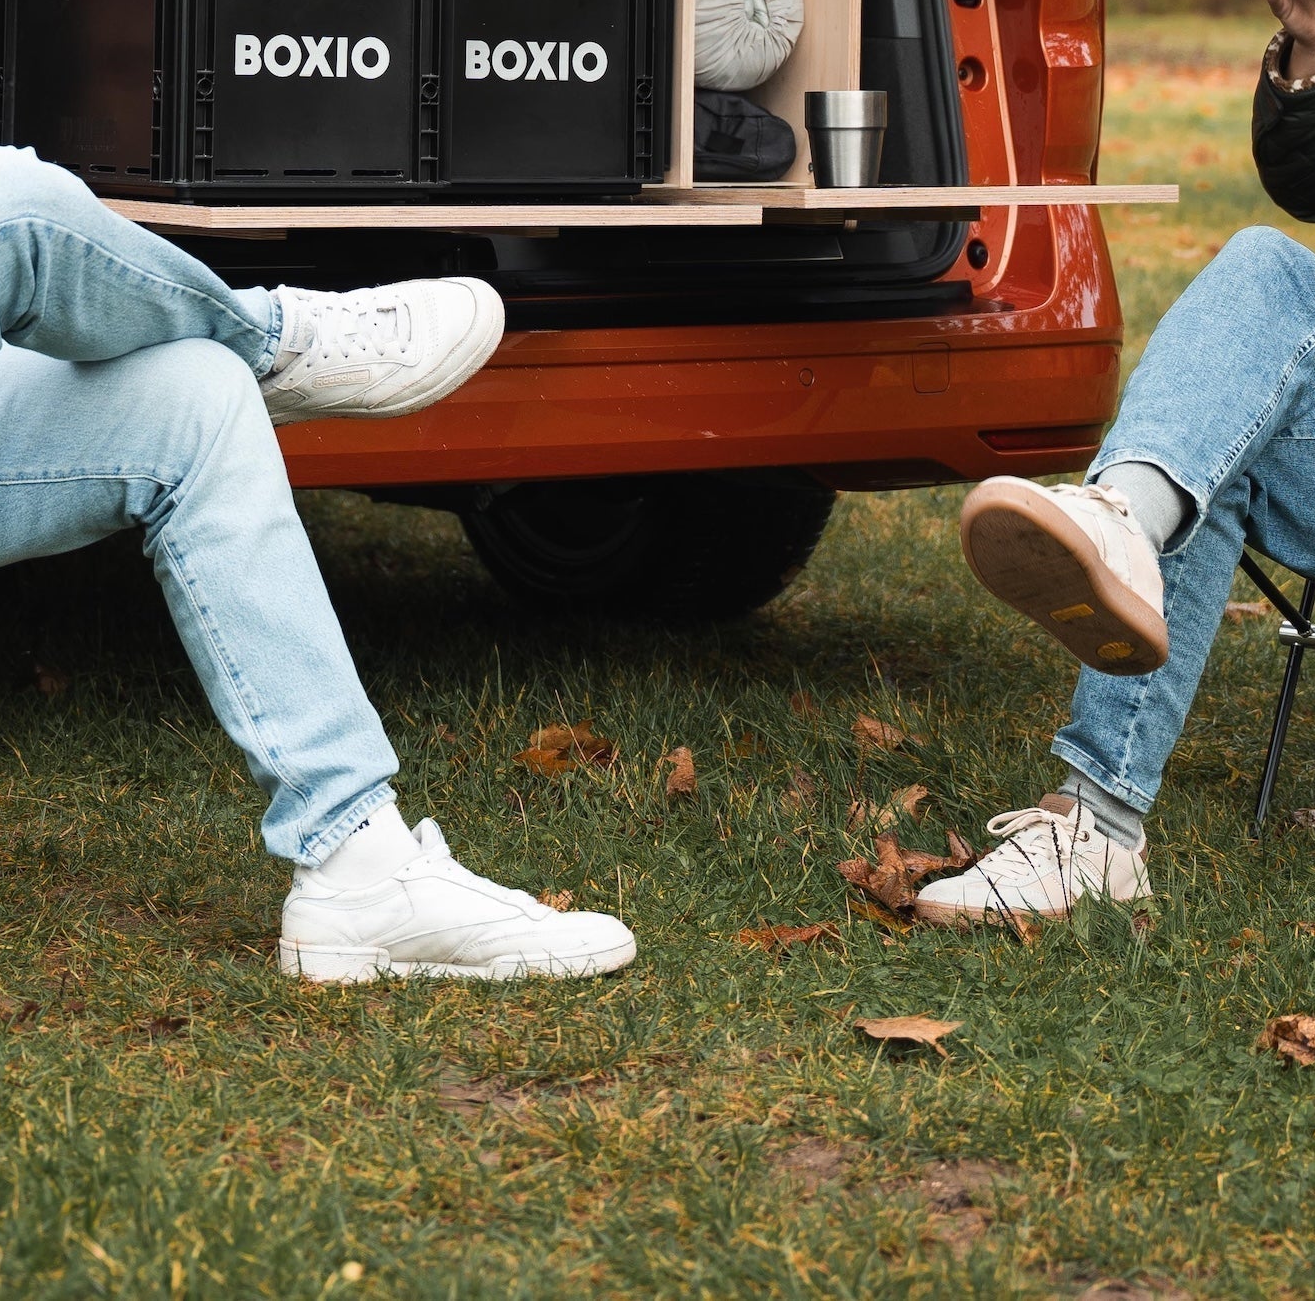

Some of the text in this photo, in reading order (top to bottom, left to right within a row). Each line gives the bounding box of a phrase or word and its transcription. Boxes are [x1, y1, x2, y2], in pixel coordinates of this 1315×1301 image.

[235, 33, 391, 79] BOXIO
[465, 39, 608, 82] BOXIO
[288, 309, 300, 349] Reebok
